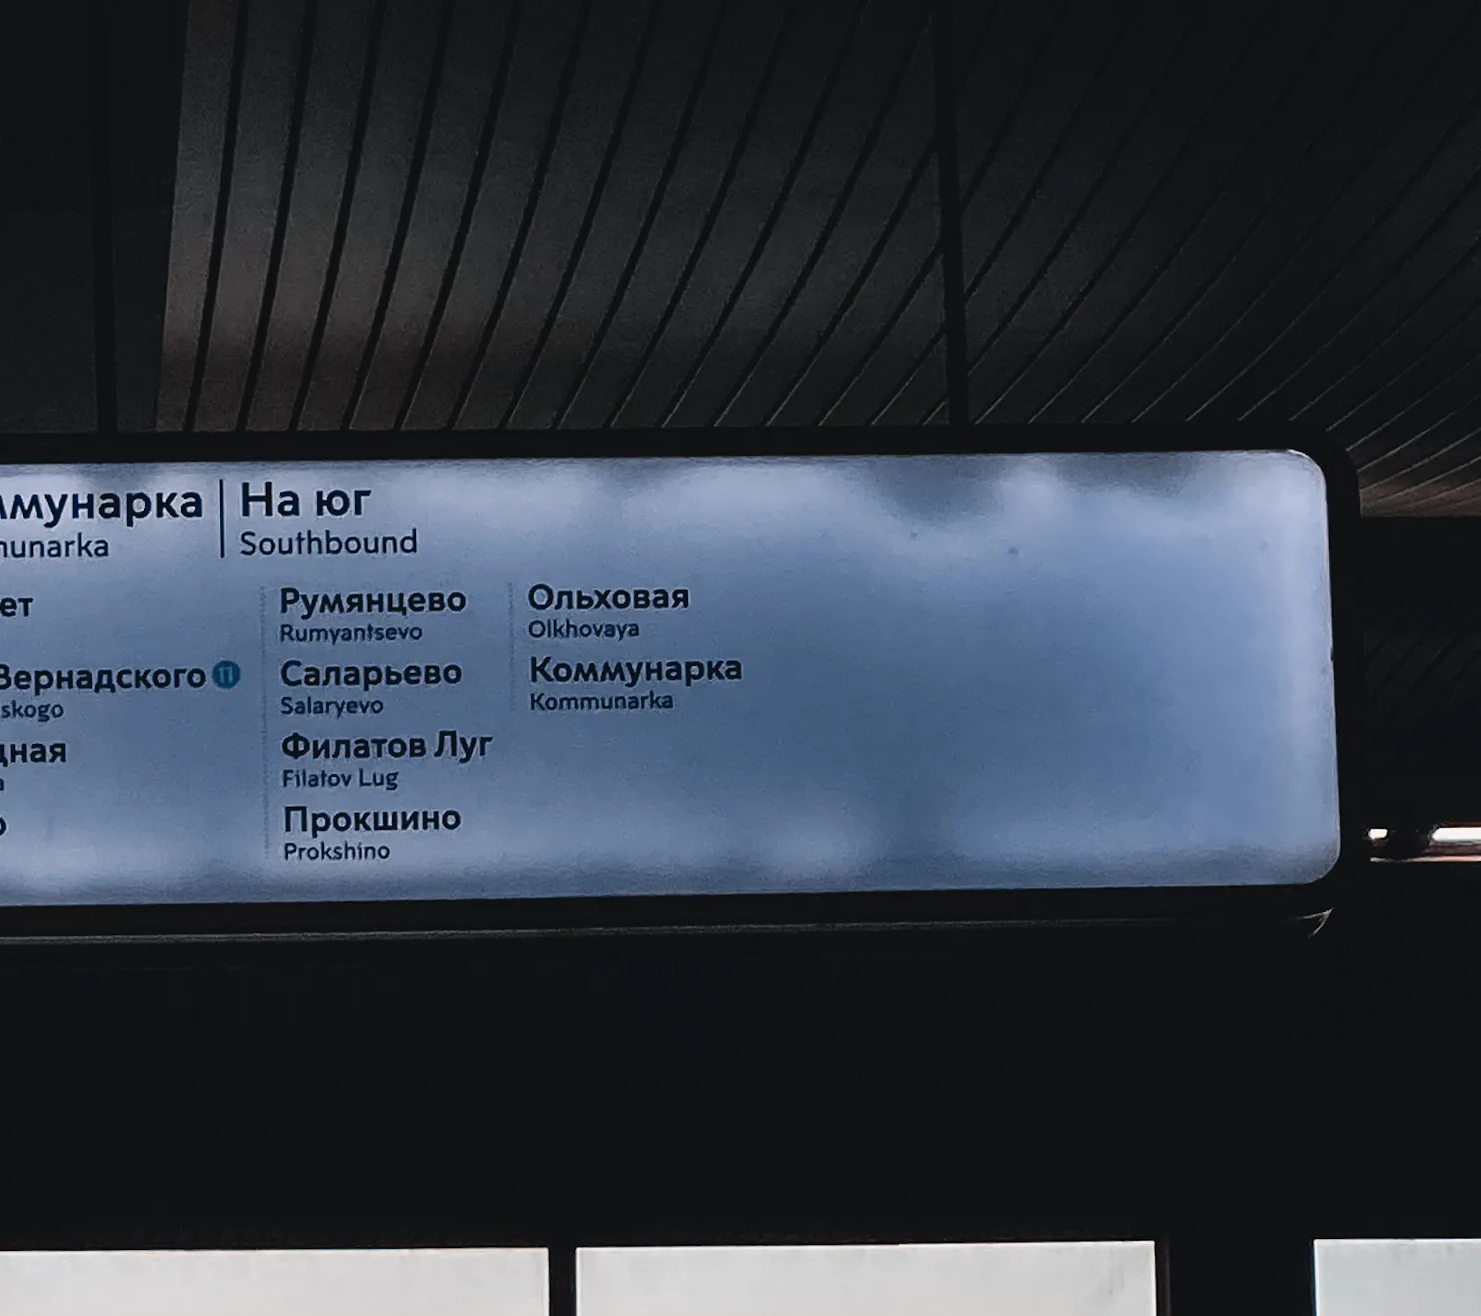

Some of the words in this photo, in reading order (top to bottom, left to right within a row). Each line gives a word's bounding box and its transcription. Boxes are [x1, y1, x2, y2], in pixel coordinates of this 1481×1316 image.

[241, 481, 300, 517] На
[316, 489, 372, 517] юг
[240, 527, 418, 556] Southbound
[280, 587, 467, 621] Румянцево
[527, 583, 689, 611] Ольховая
[279, 623, 423, 646] Rumyantsevo
[528, 618, 640, 642] Olkhovaya
[280, 659, 462, 692] Саларьево
[530, 656, 742, 688] Коммунарка
[280, 695, 384, 719] Salaryevo
[530, 689, 674, 712] Kommunarka
[281, 732, 427, 760] Филатов
[433, 729, 494, 764] Луг
[282, 768, 352, 788] Filatov
[358, 767, 400, 791] Lug
[284, 805, 462, 839] Прокшино
[284, 840, 391, 861] Prokshino
